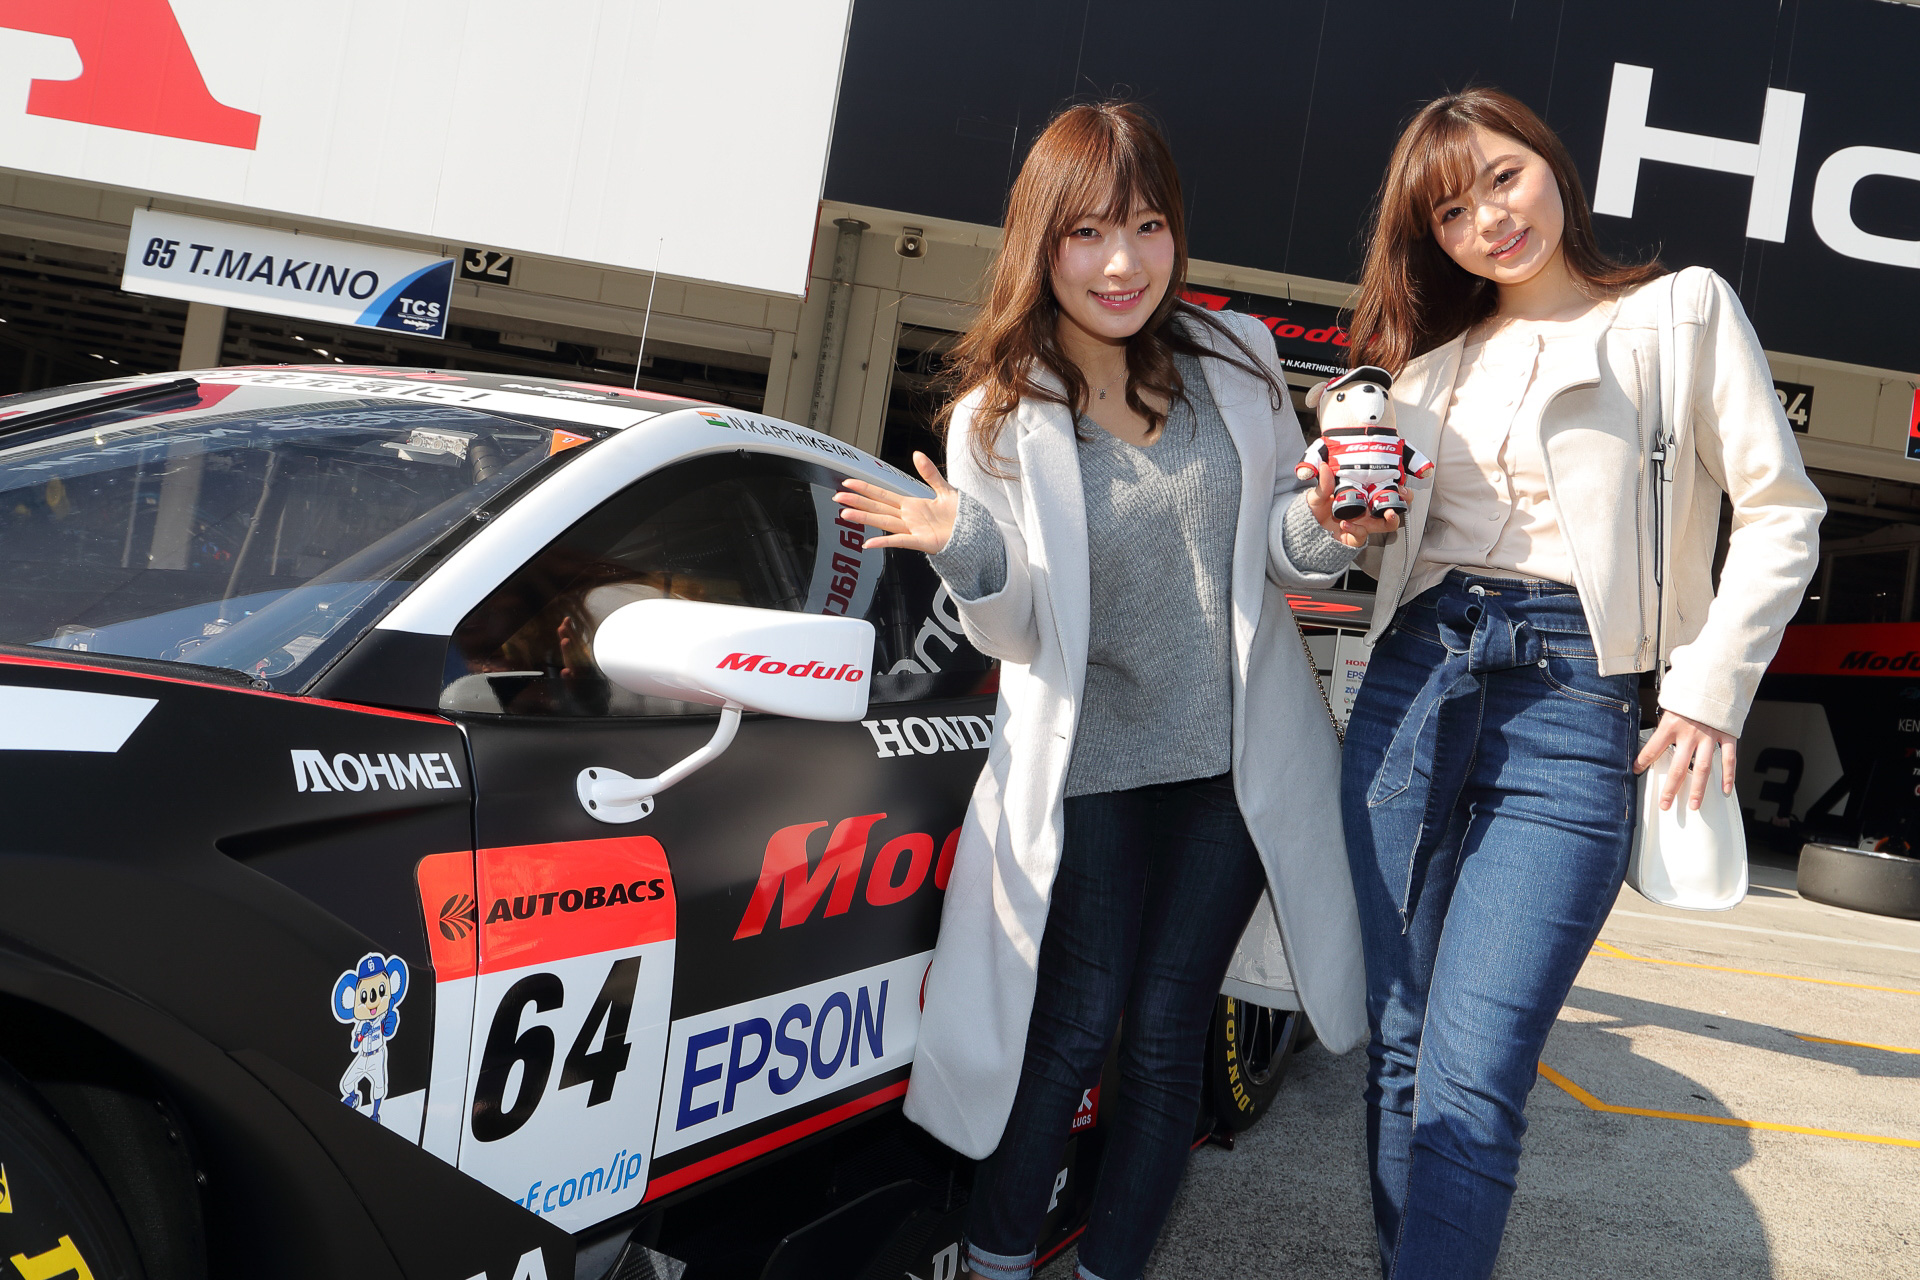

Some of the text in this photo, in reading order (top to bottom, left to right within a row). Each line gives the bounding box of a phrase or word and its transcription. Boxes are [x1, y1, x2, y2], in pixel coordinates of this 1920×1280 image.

[142, 237, 379, 300] 65 T.MAKINO
[465, 249, 509, 278] 32
[399, 297, 440, 318] TCS
[727, 415, 860, 461] N.KARTHIKEYAN
[1345, 444, 1397, 453] Modulo
[716, 652, 864, 683] Modulo
[484, 878, 665, 925] AUTOBACS
[471, 954, 642, 1144] 64
[674, 979, 889, 1132] EPSON
